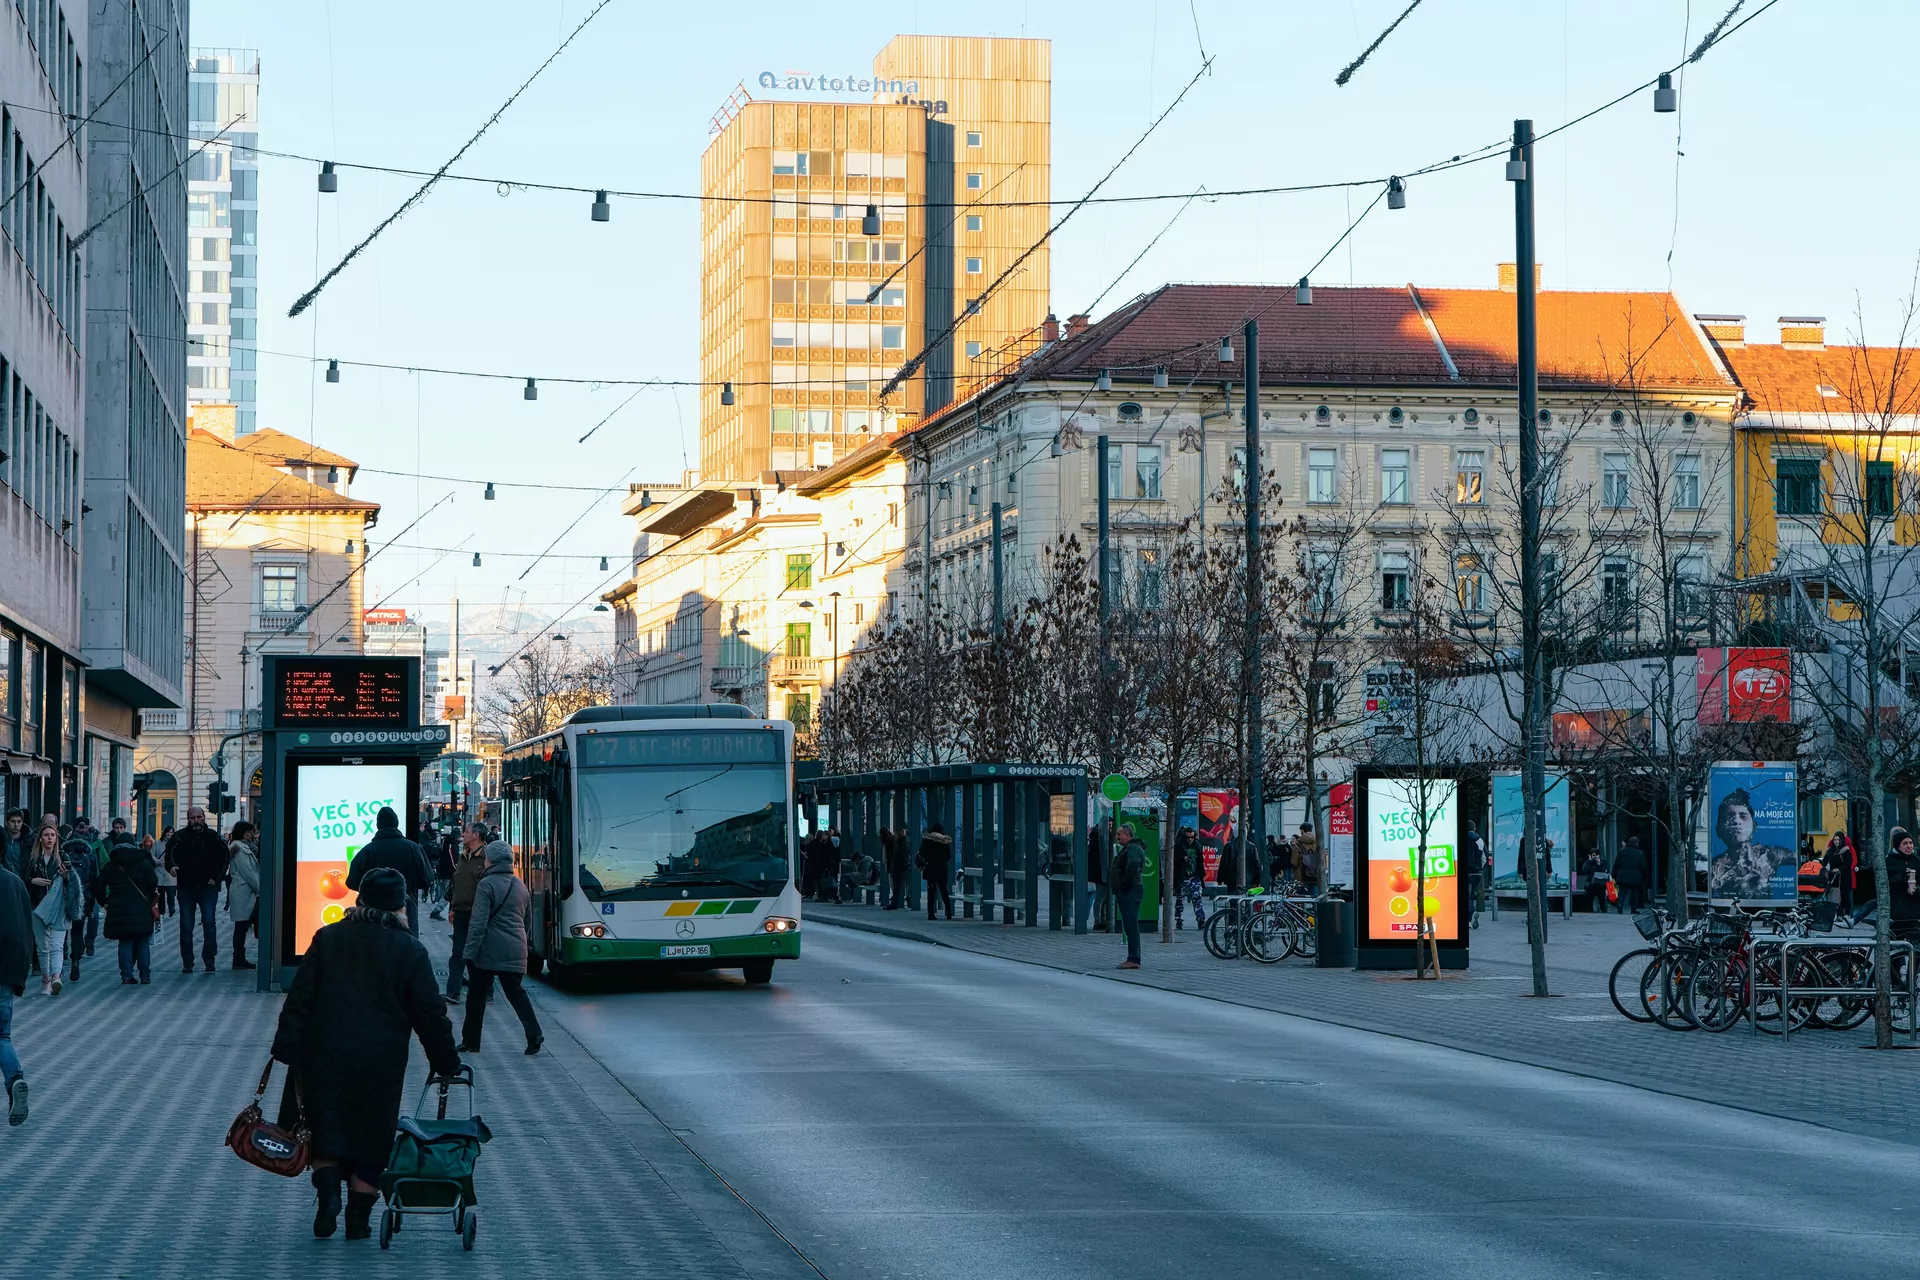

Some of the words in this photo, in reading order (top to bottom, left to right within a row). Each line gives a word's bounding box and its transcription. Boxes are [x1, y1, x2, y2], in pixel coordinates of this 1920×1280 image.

[786, 74, 919, 93] avtotehna
[311, 799, 350, 821] VEČ
[1379, 808, 1411, 825] VEČ
[1754, 810, 1765, 818] NA
[1766, 810, 1783, 819] MOJE
[1784, 810, 1794, 818] OČI
[313, 821, 356, 840] 1300
[361, 820, 374, 835] X
[1381, 827, 1416, 842] 1300
[1202, 845, 1218, 853] Ples
[667, 947, 677, 955] LJ
